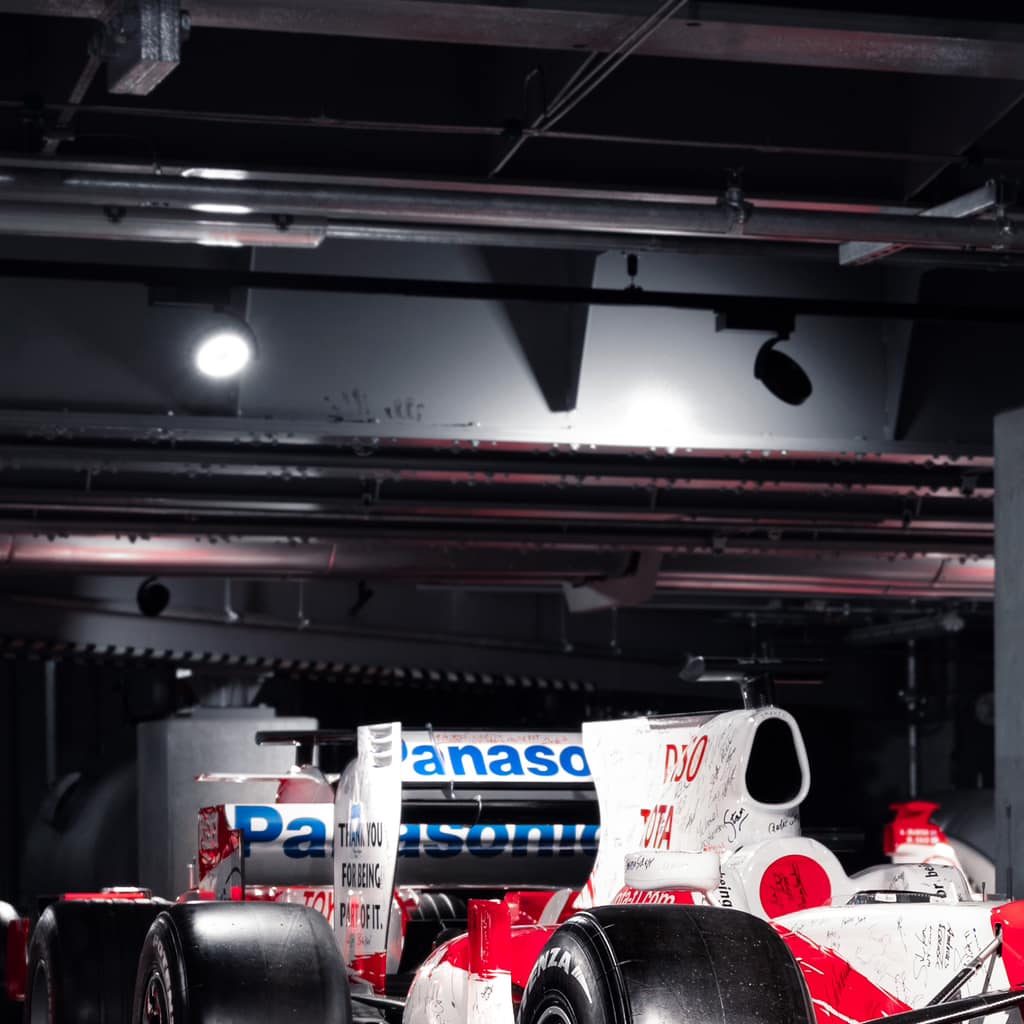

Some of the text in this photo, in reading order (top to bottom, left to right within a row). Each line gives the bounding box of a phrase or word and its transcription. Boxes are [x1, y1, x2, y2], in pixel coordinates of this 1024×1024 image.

[366, 822, 383, 848] YOU
[341, 862, 381, 889] FOR BEING
[360, 903, 371, 930] OF
